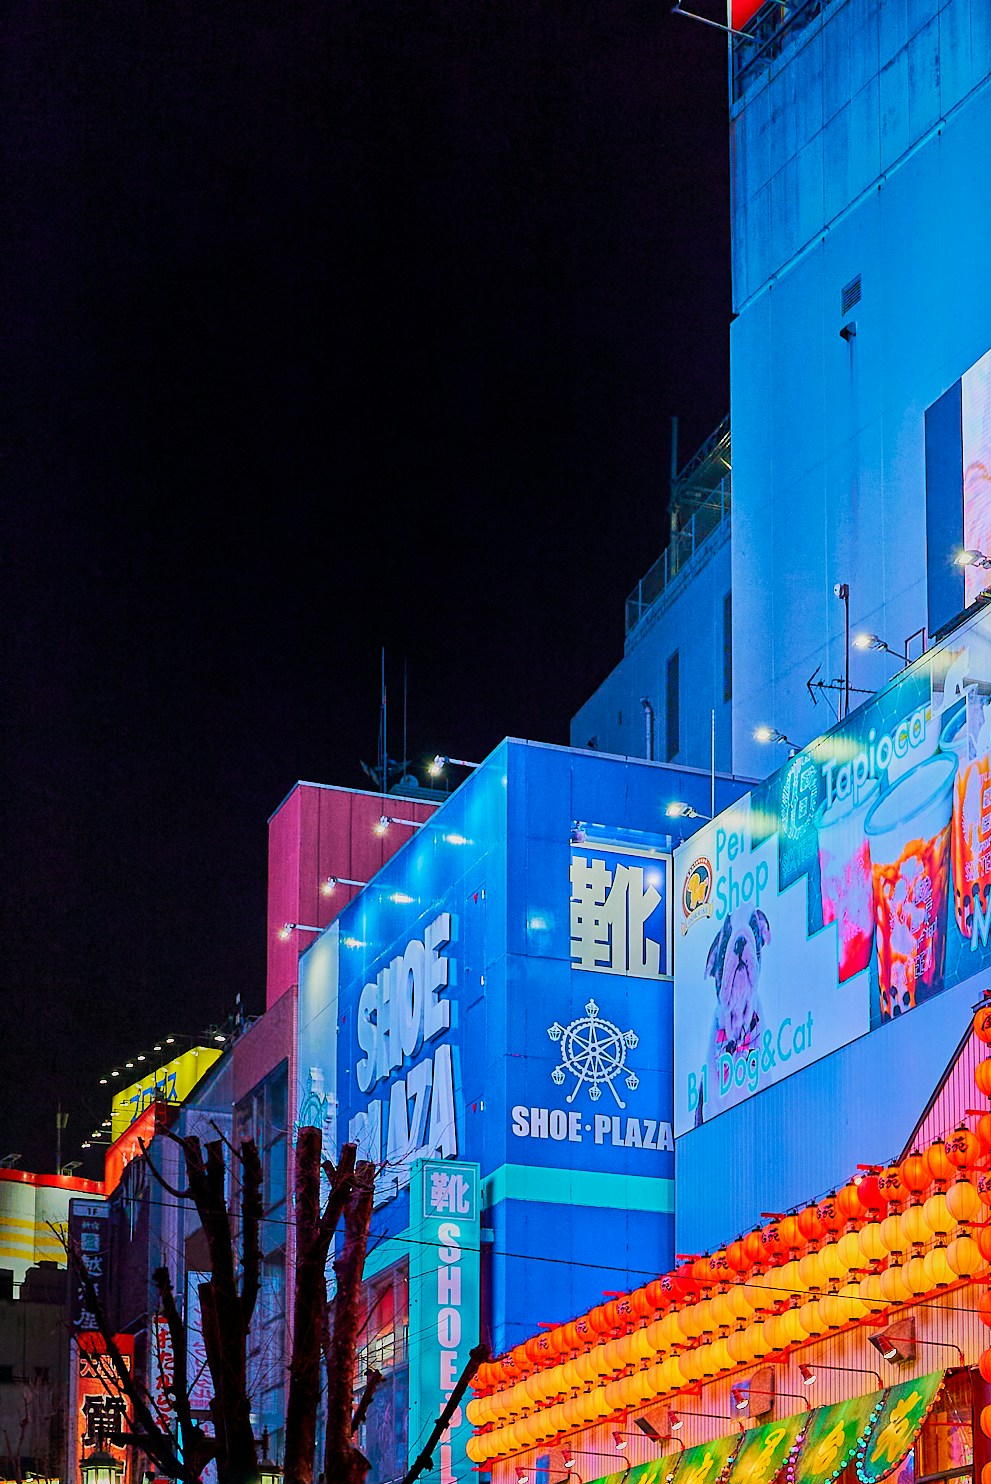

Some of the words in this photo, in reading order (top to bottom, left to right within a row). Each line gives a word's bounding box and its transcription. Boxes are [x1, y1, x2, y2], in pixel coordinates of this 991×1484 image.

[822, 702, 928, 807] Tapioca
[570, 854, 663, 977] 靴
[714, 855, 769, 921] Shop
[356, 912, 451, 1094] SHOE
[718, 1010, 814, 1096] Dog&Cat
[429, 1172, 472, 1214] 靴
